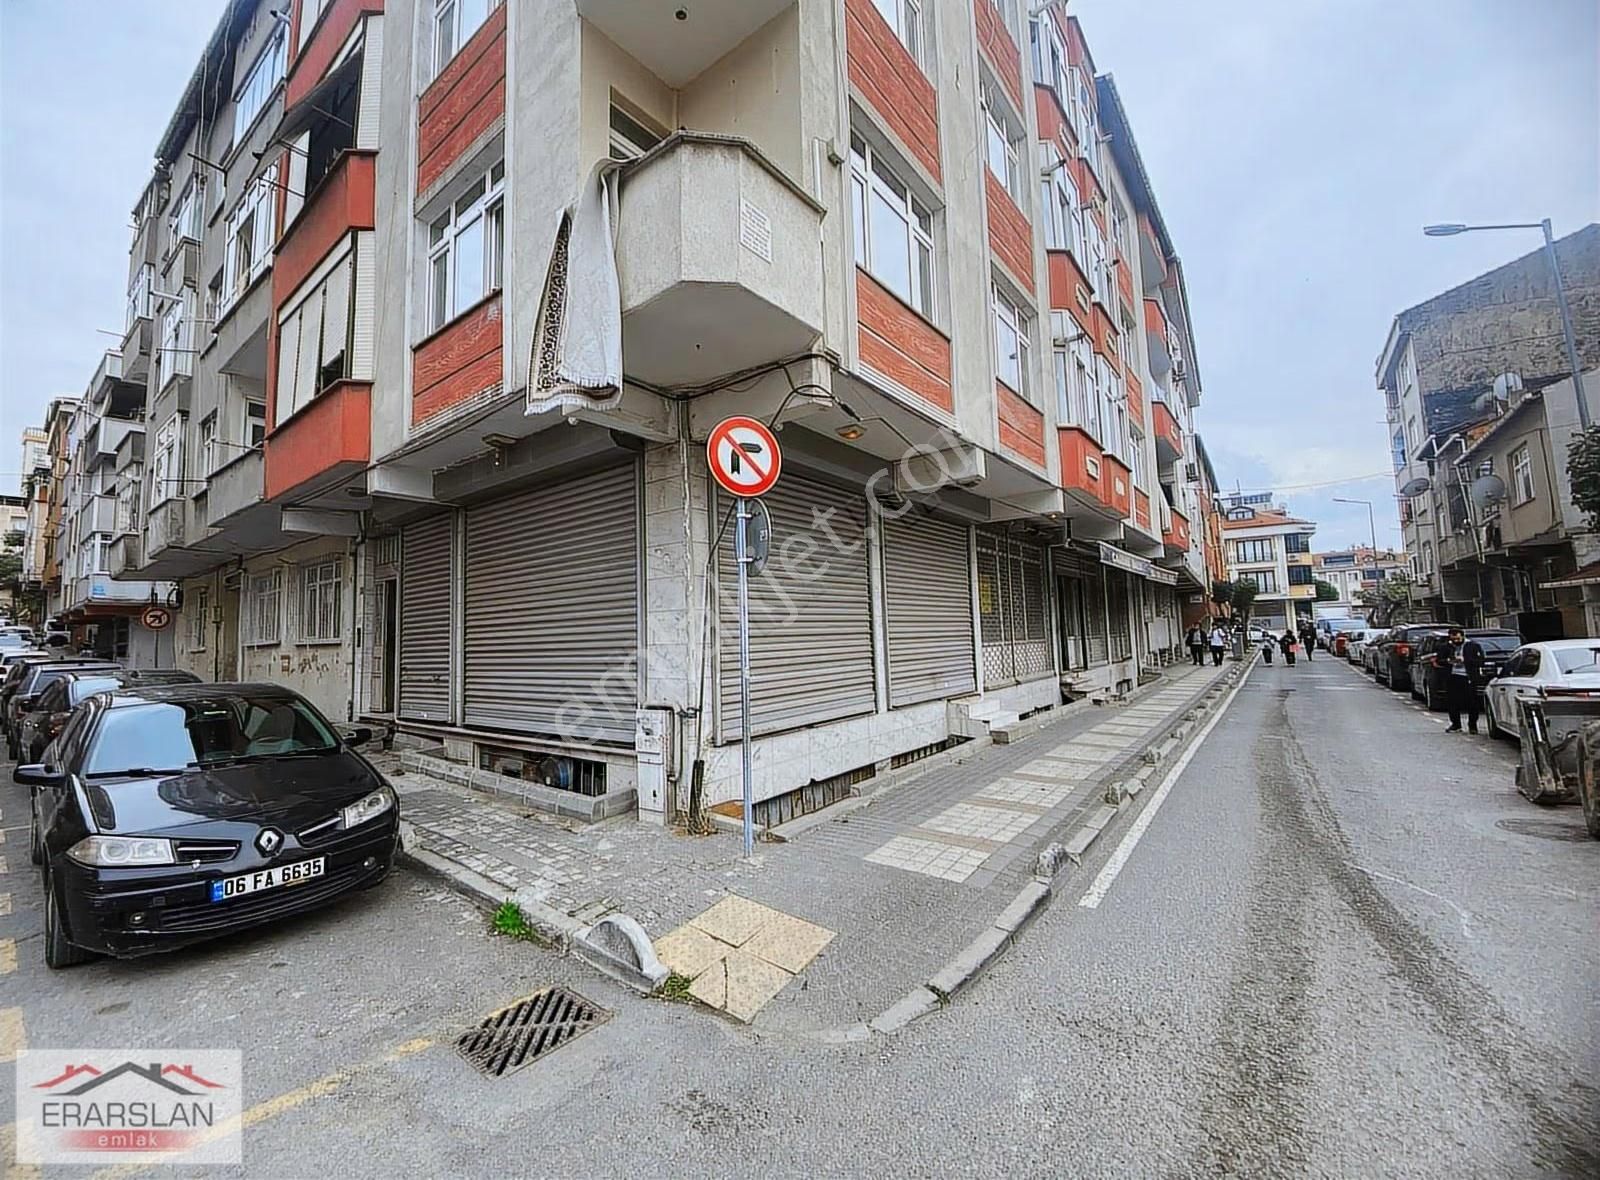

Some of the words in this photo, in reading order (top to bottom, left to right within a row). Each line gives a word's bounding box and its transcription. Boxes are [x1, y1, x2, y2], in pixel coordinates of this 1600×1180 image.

[224, 877, 246, 896] 06
[253, 870, 274, 890] FA
[281, 860, 321, 883] 6635
